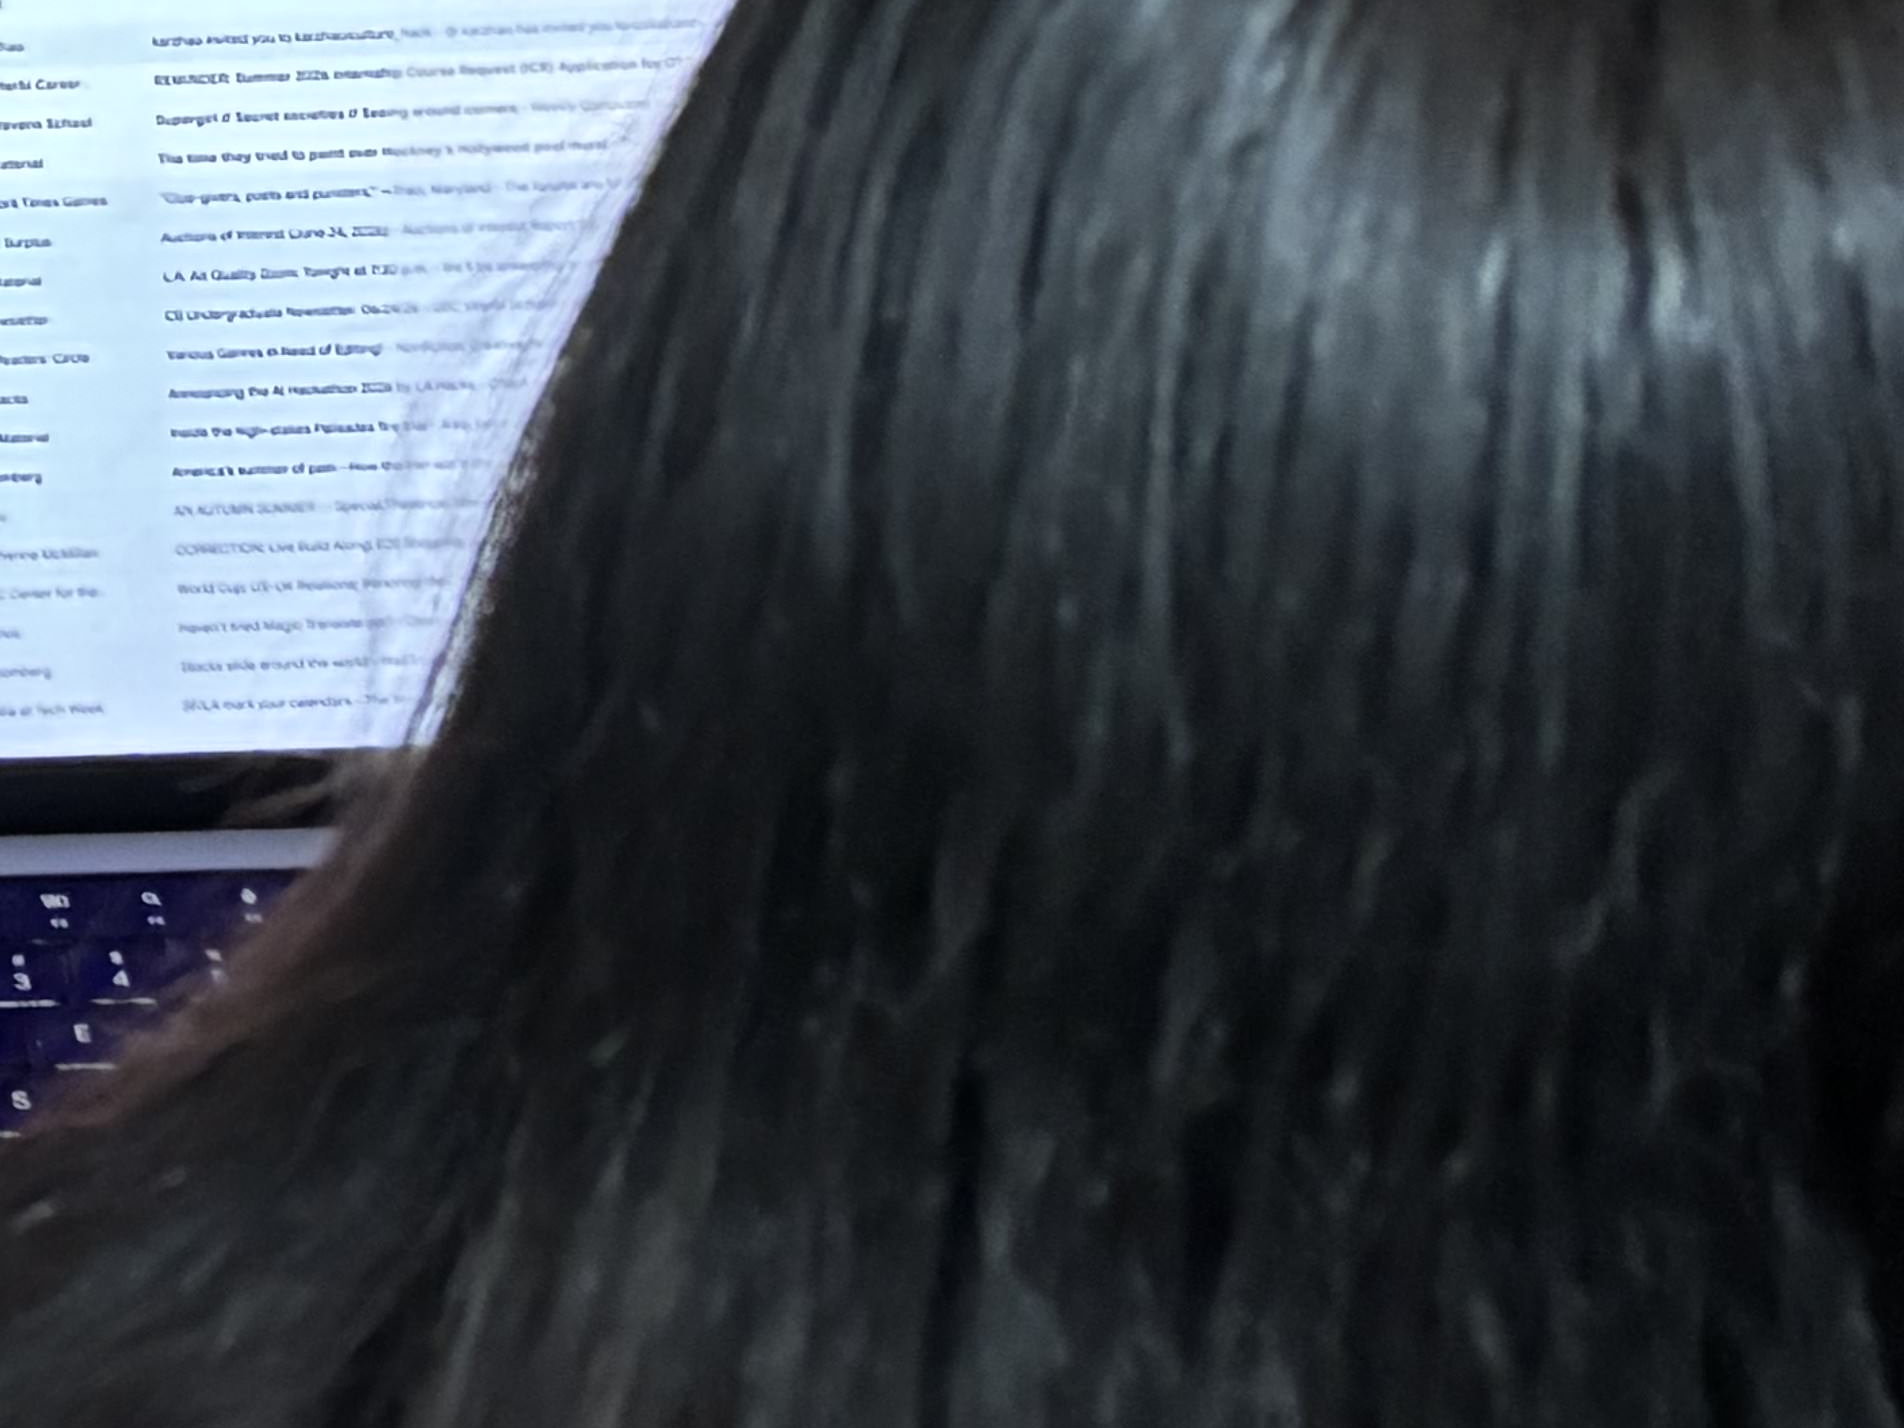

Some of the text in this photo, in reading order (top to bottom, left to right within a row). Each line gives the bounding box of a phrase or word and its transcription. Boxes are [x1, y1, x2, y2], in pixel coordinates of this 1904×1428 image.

[13, 973, 32, 991] 3
[111, 969, 130, 987] 4
[73, 1023, 91, 1043] E
[10, 1089, 32, 1111] S
